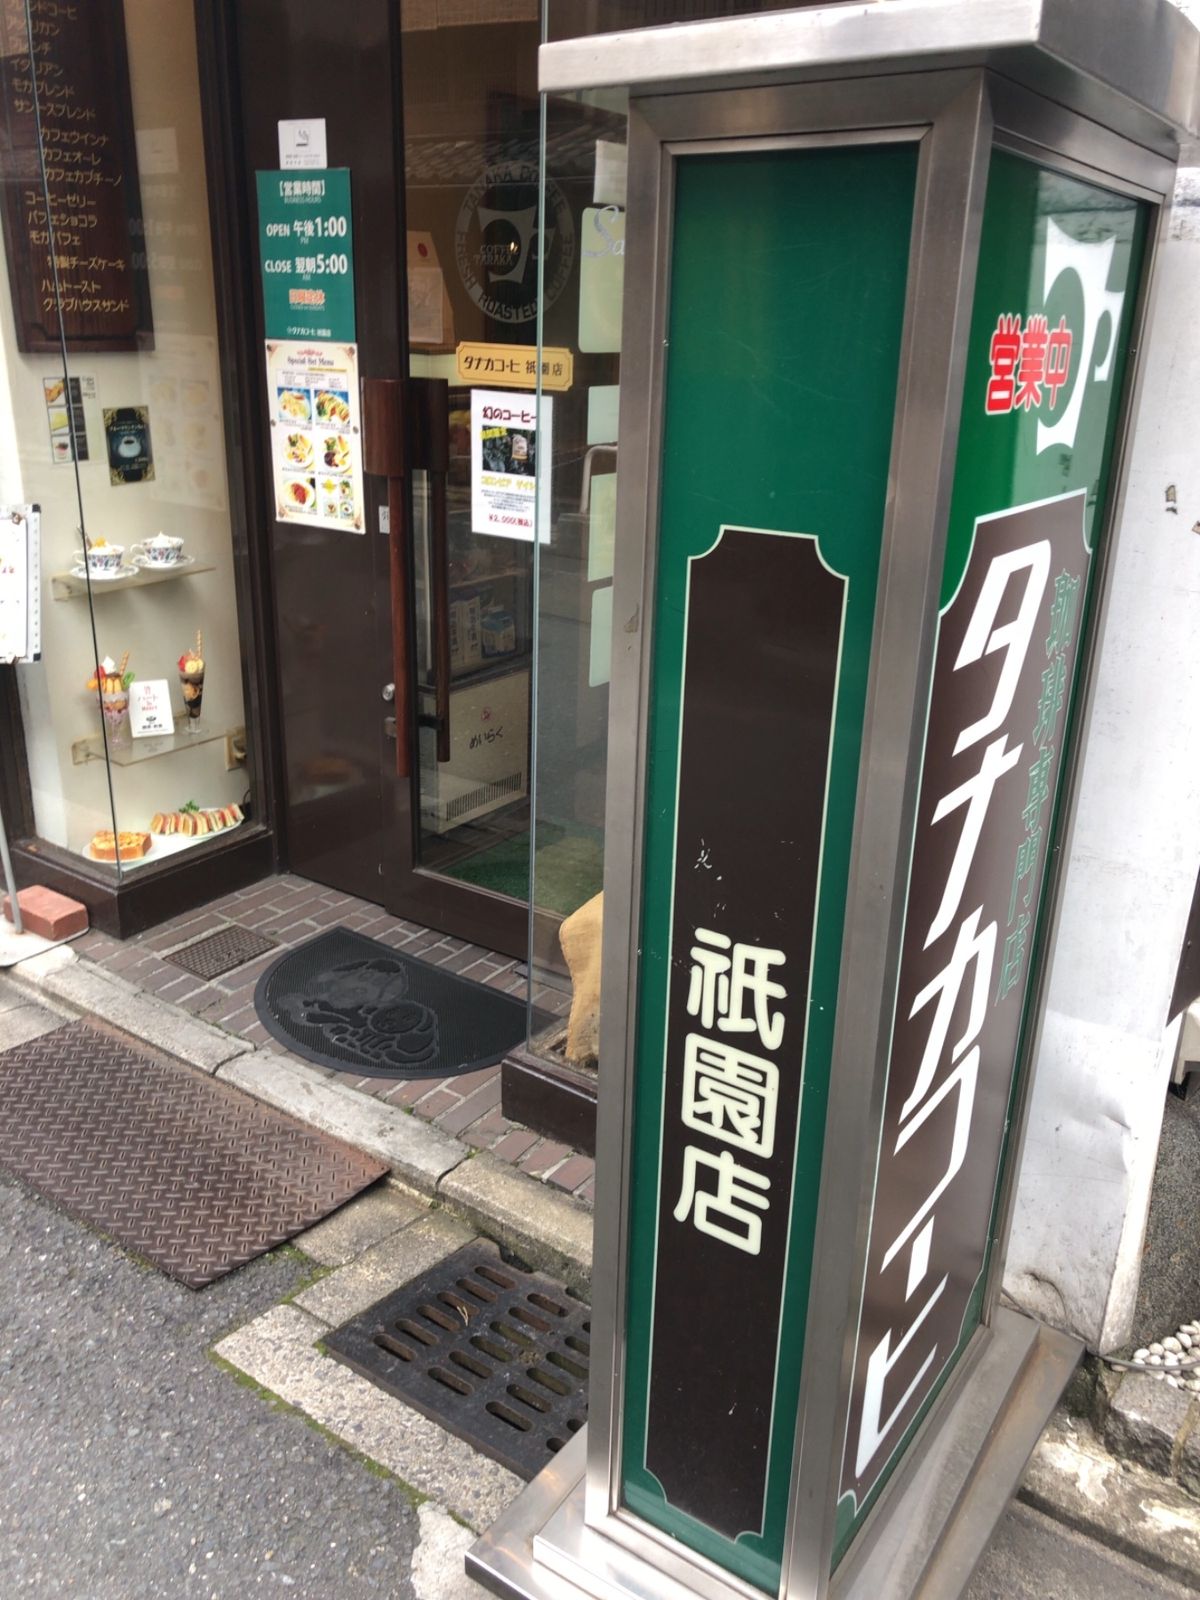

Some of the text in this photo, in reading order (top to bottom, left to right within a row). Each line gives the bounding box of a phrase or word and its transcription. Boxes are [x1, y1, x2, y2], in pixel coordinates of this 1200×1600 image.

[43, 147, 101, 166] カフェオーレ
[25, 190, 97, 209] コーヒーゼリー
[266, 216, 347, 238] OPEN 午後1:00
[30, 230, 81, 246] モカパフェ
[264, 260, 292, 273] CLOSE
[41, 279, 101, 293] ハムトースト
[985, 313, 1073, 415] 営業中
[469, 725, 504, 750] めいらく
[673, 927, 787, 1256] 祇園店
